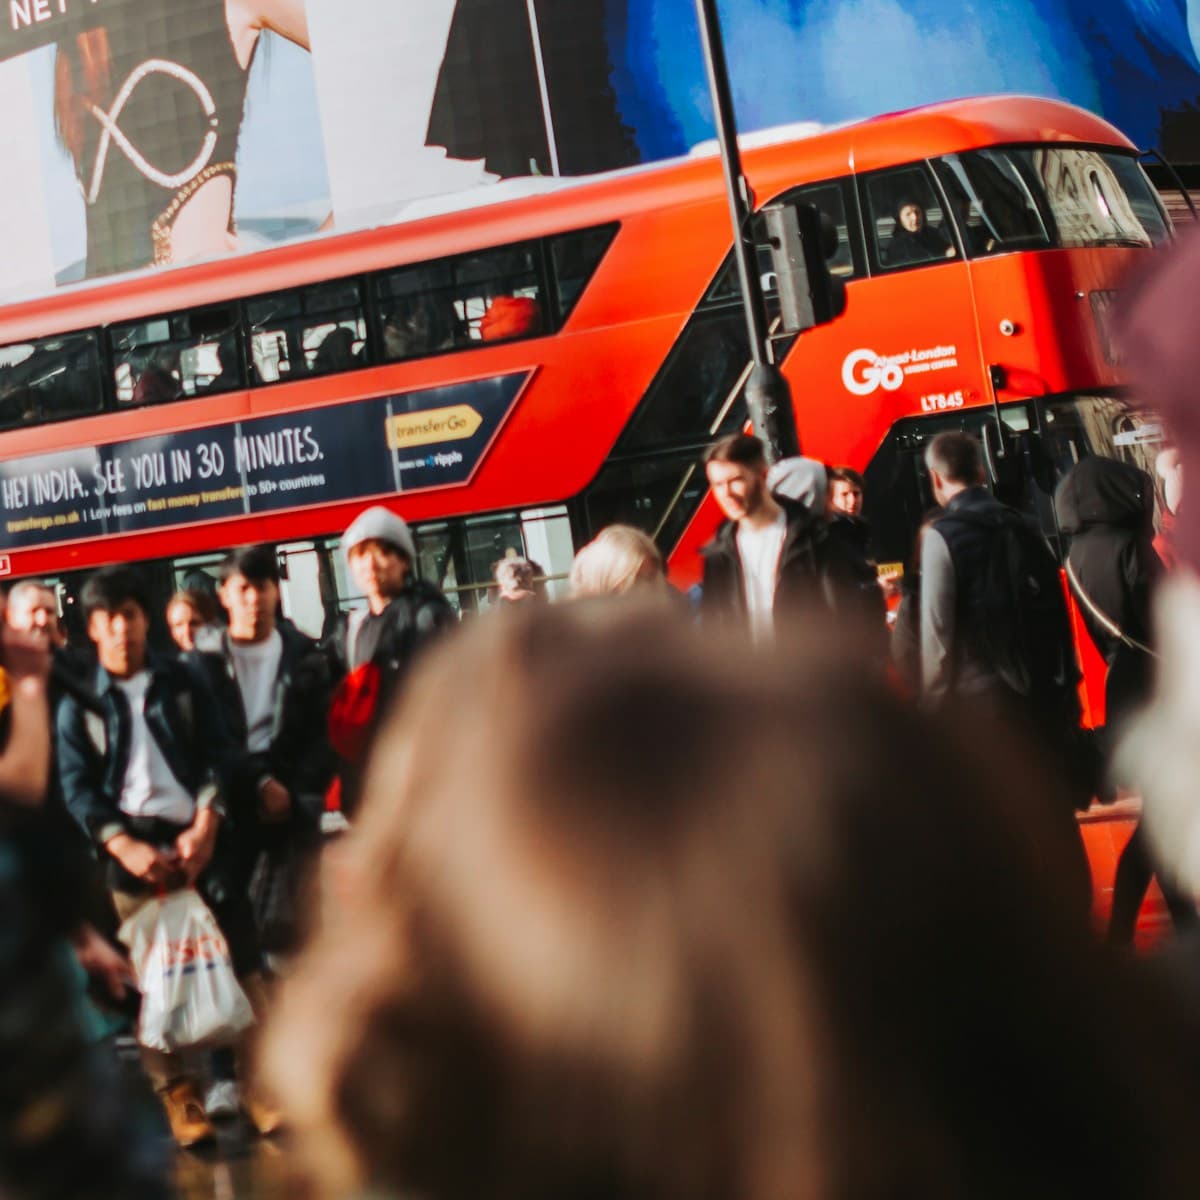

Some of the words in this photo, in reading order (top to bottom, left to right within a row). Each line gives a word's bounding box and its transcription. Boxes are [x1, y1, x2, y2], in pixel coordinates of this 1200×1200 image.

[841, 348, 904, 396] Go
[397, 415, 468, 438] transferGo
[2, 475, 29, 509] HEY
[33, 467, 89, 506] INDIA.
[93, 458, 126, 496] SEE
[131, 452, 166, 491] YOU
[170, 449, 191, 483] IN
[197, 442, 224, 479] 30
[234, 425, 324, 473] MINUTES.
[90, 507, 111, 520] Low
[134, 502, 146, 513] on
[258, 479, 277, 494] 50+
[279, 473, 325, 492] countries
